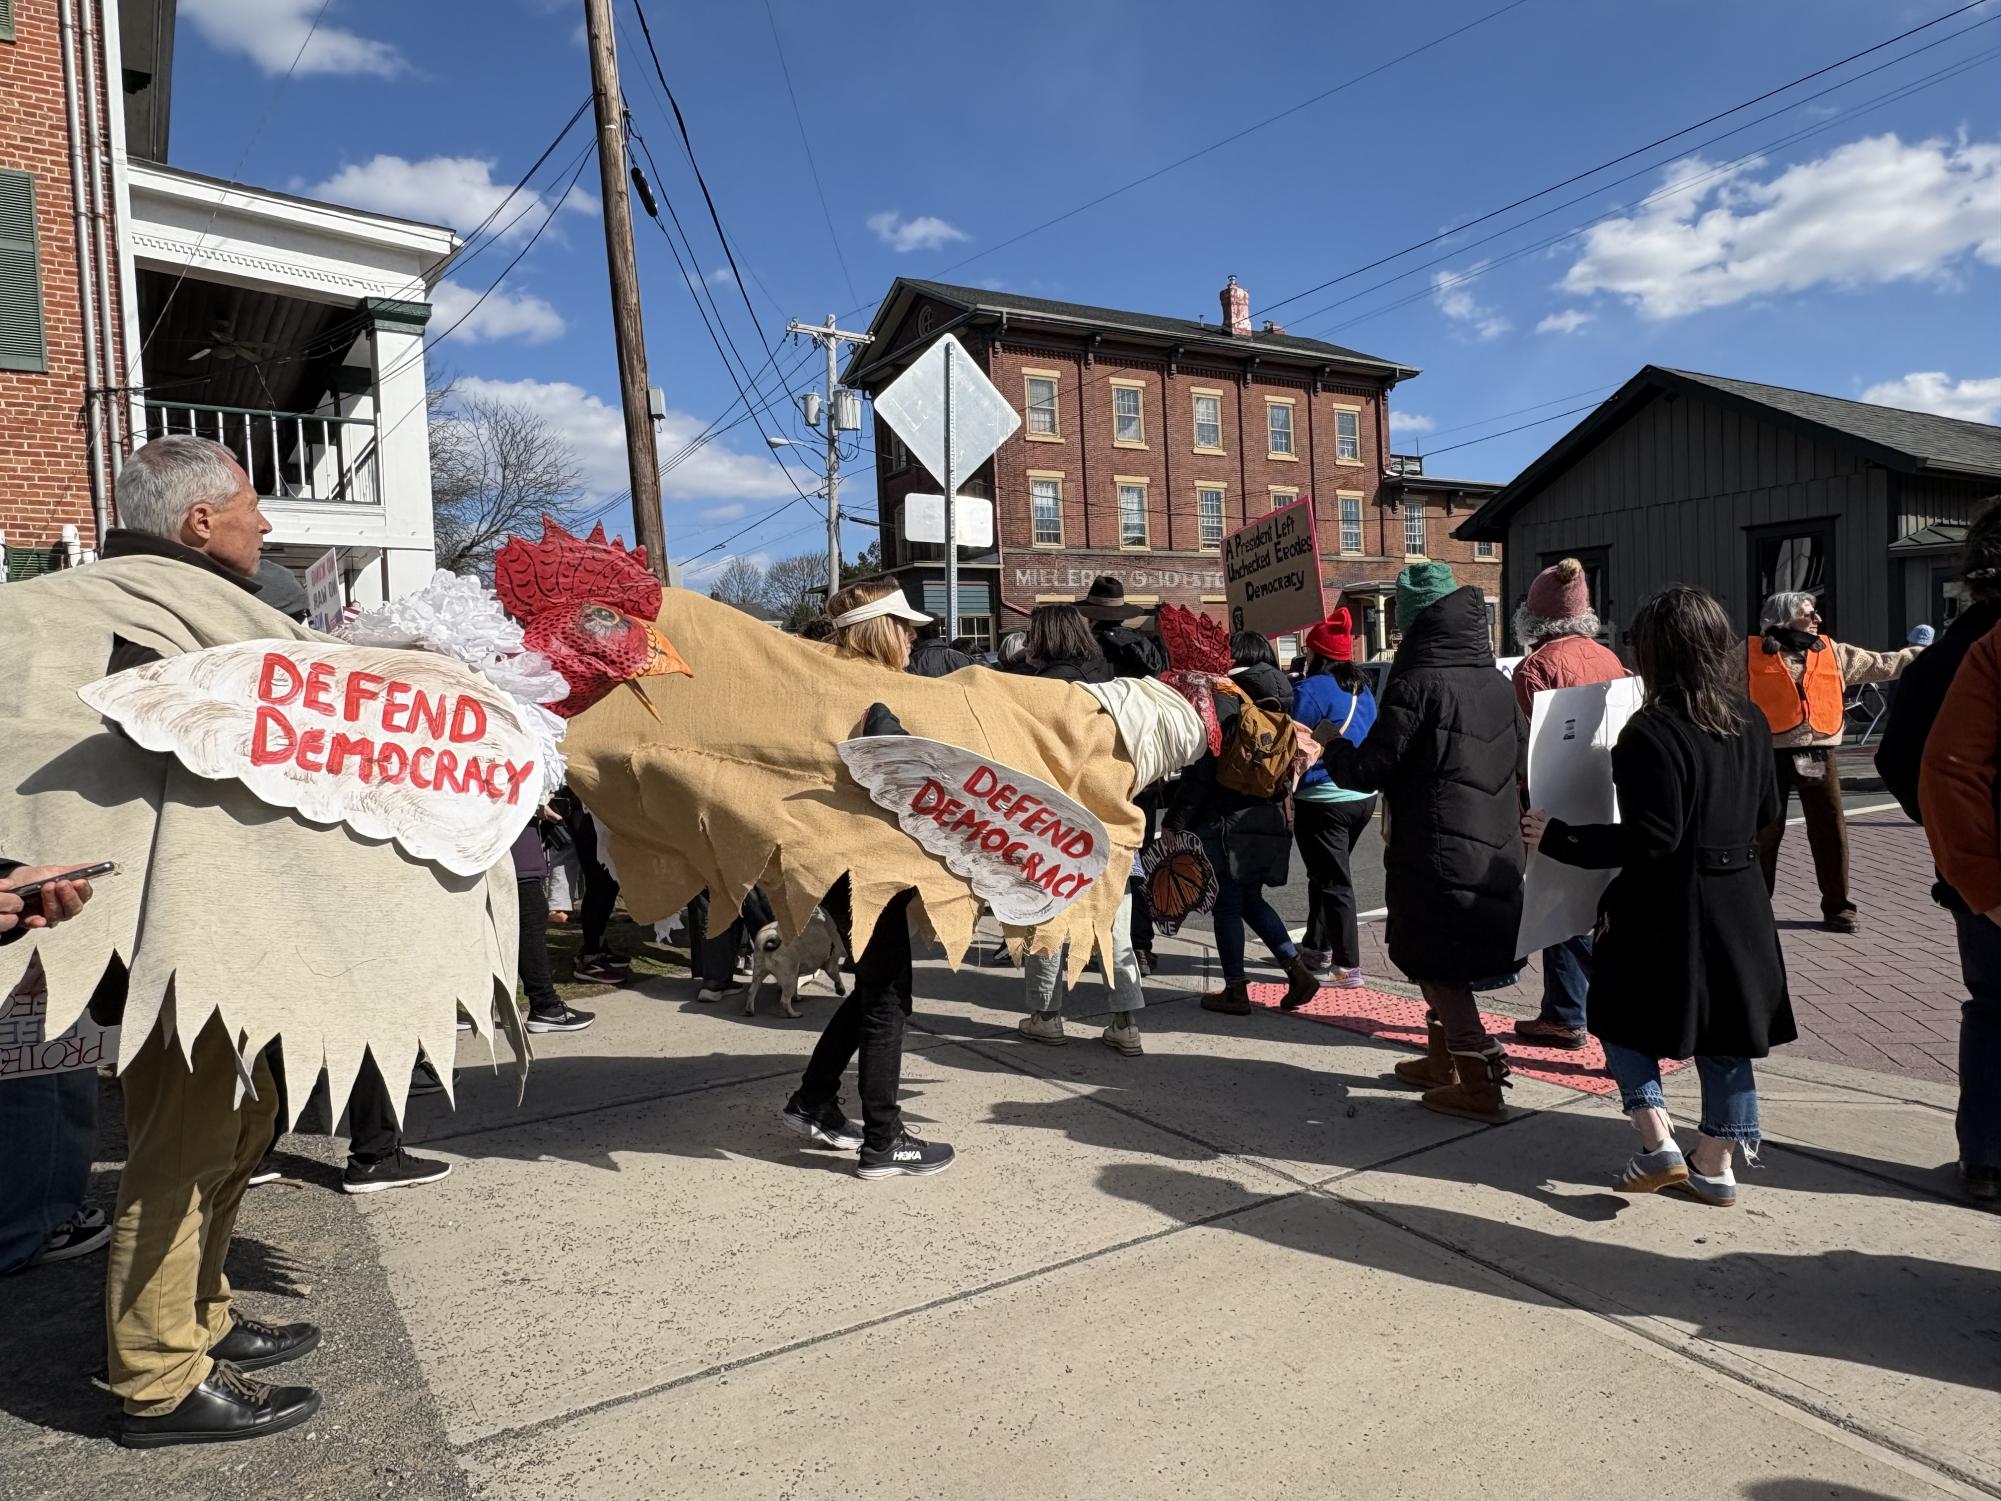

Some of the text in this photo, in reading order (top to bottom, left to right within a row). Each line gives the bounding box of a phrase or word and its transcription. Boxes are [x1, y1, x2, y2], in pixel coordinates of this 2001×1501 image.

[1226, 515, 1295, 562] A President Left
[1227, 549, 1271, 582] Unchecked
[258, 652, 488, 743] DEFEND
[250, 705, 535, 805] DEMOCRACY
[910, 778, 1093, 899] DEMOCRACY
[963, 765, 1094, 859] DEFEND
[1141, 840, 1164, 874] ONLY
[1156, 876, 1217, 935] WE WANT
[893, 1151, 922, 1160] HOKA
